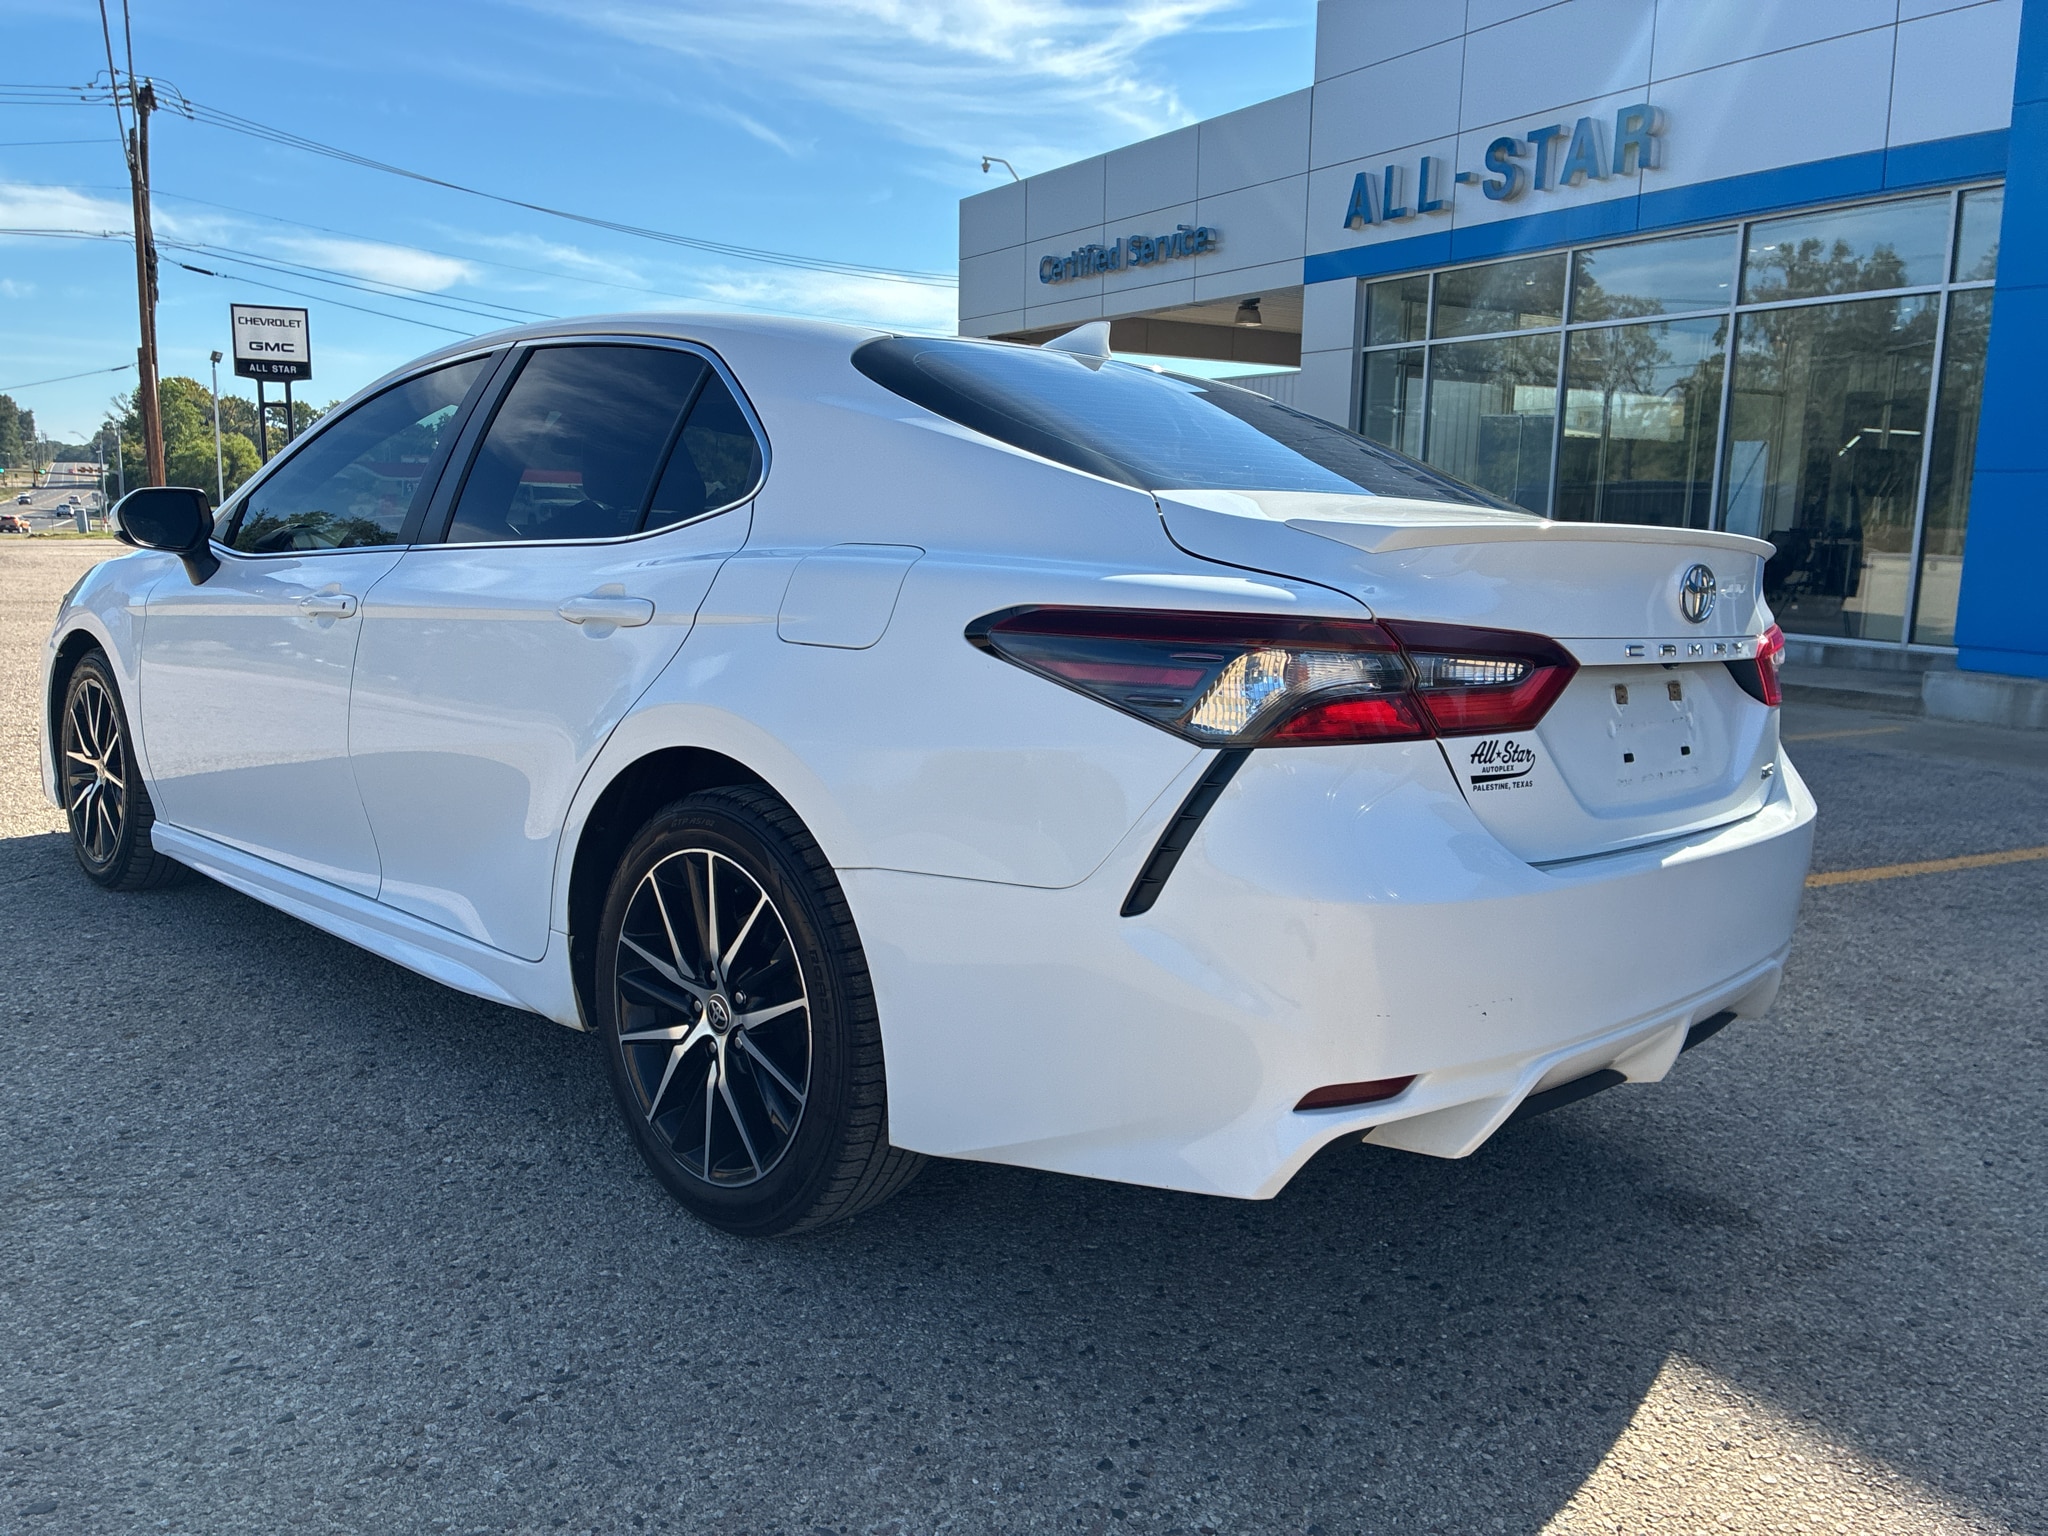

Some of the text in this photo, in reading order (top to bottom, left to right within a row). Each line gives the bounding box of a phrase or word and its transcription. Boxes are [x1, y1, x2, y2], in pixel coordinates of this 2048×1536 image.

[1343, 102, 1665, 230] ALL-STAR
[1039, 223, 1218, 284] Certified Service
[237, 315, 302, 329] CHEVROLET
[248, 341, 295, 353] GMC
[248, 363, 297, 374] ALL STAR
[1624, 642, 1744, 658] CAMRY
[1481, 764, 1515, 774] AUTOPLEX
[1472, 780, 1534, 792] PALESTINE, TEXAS
